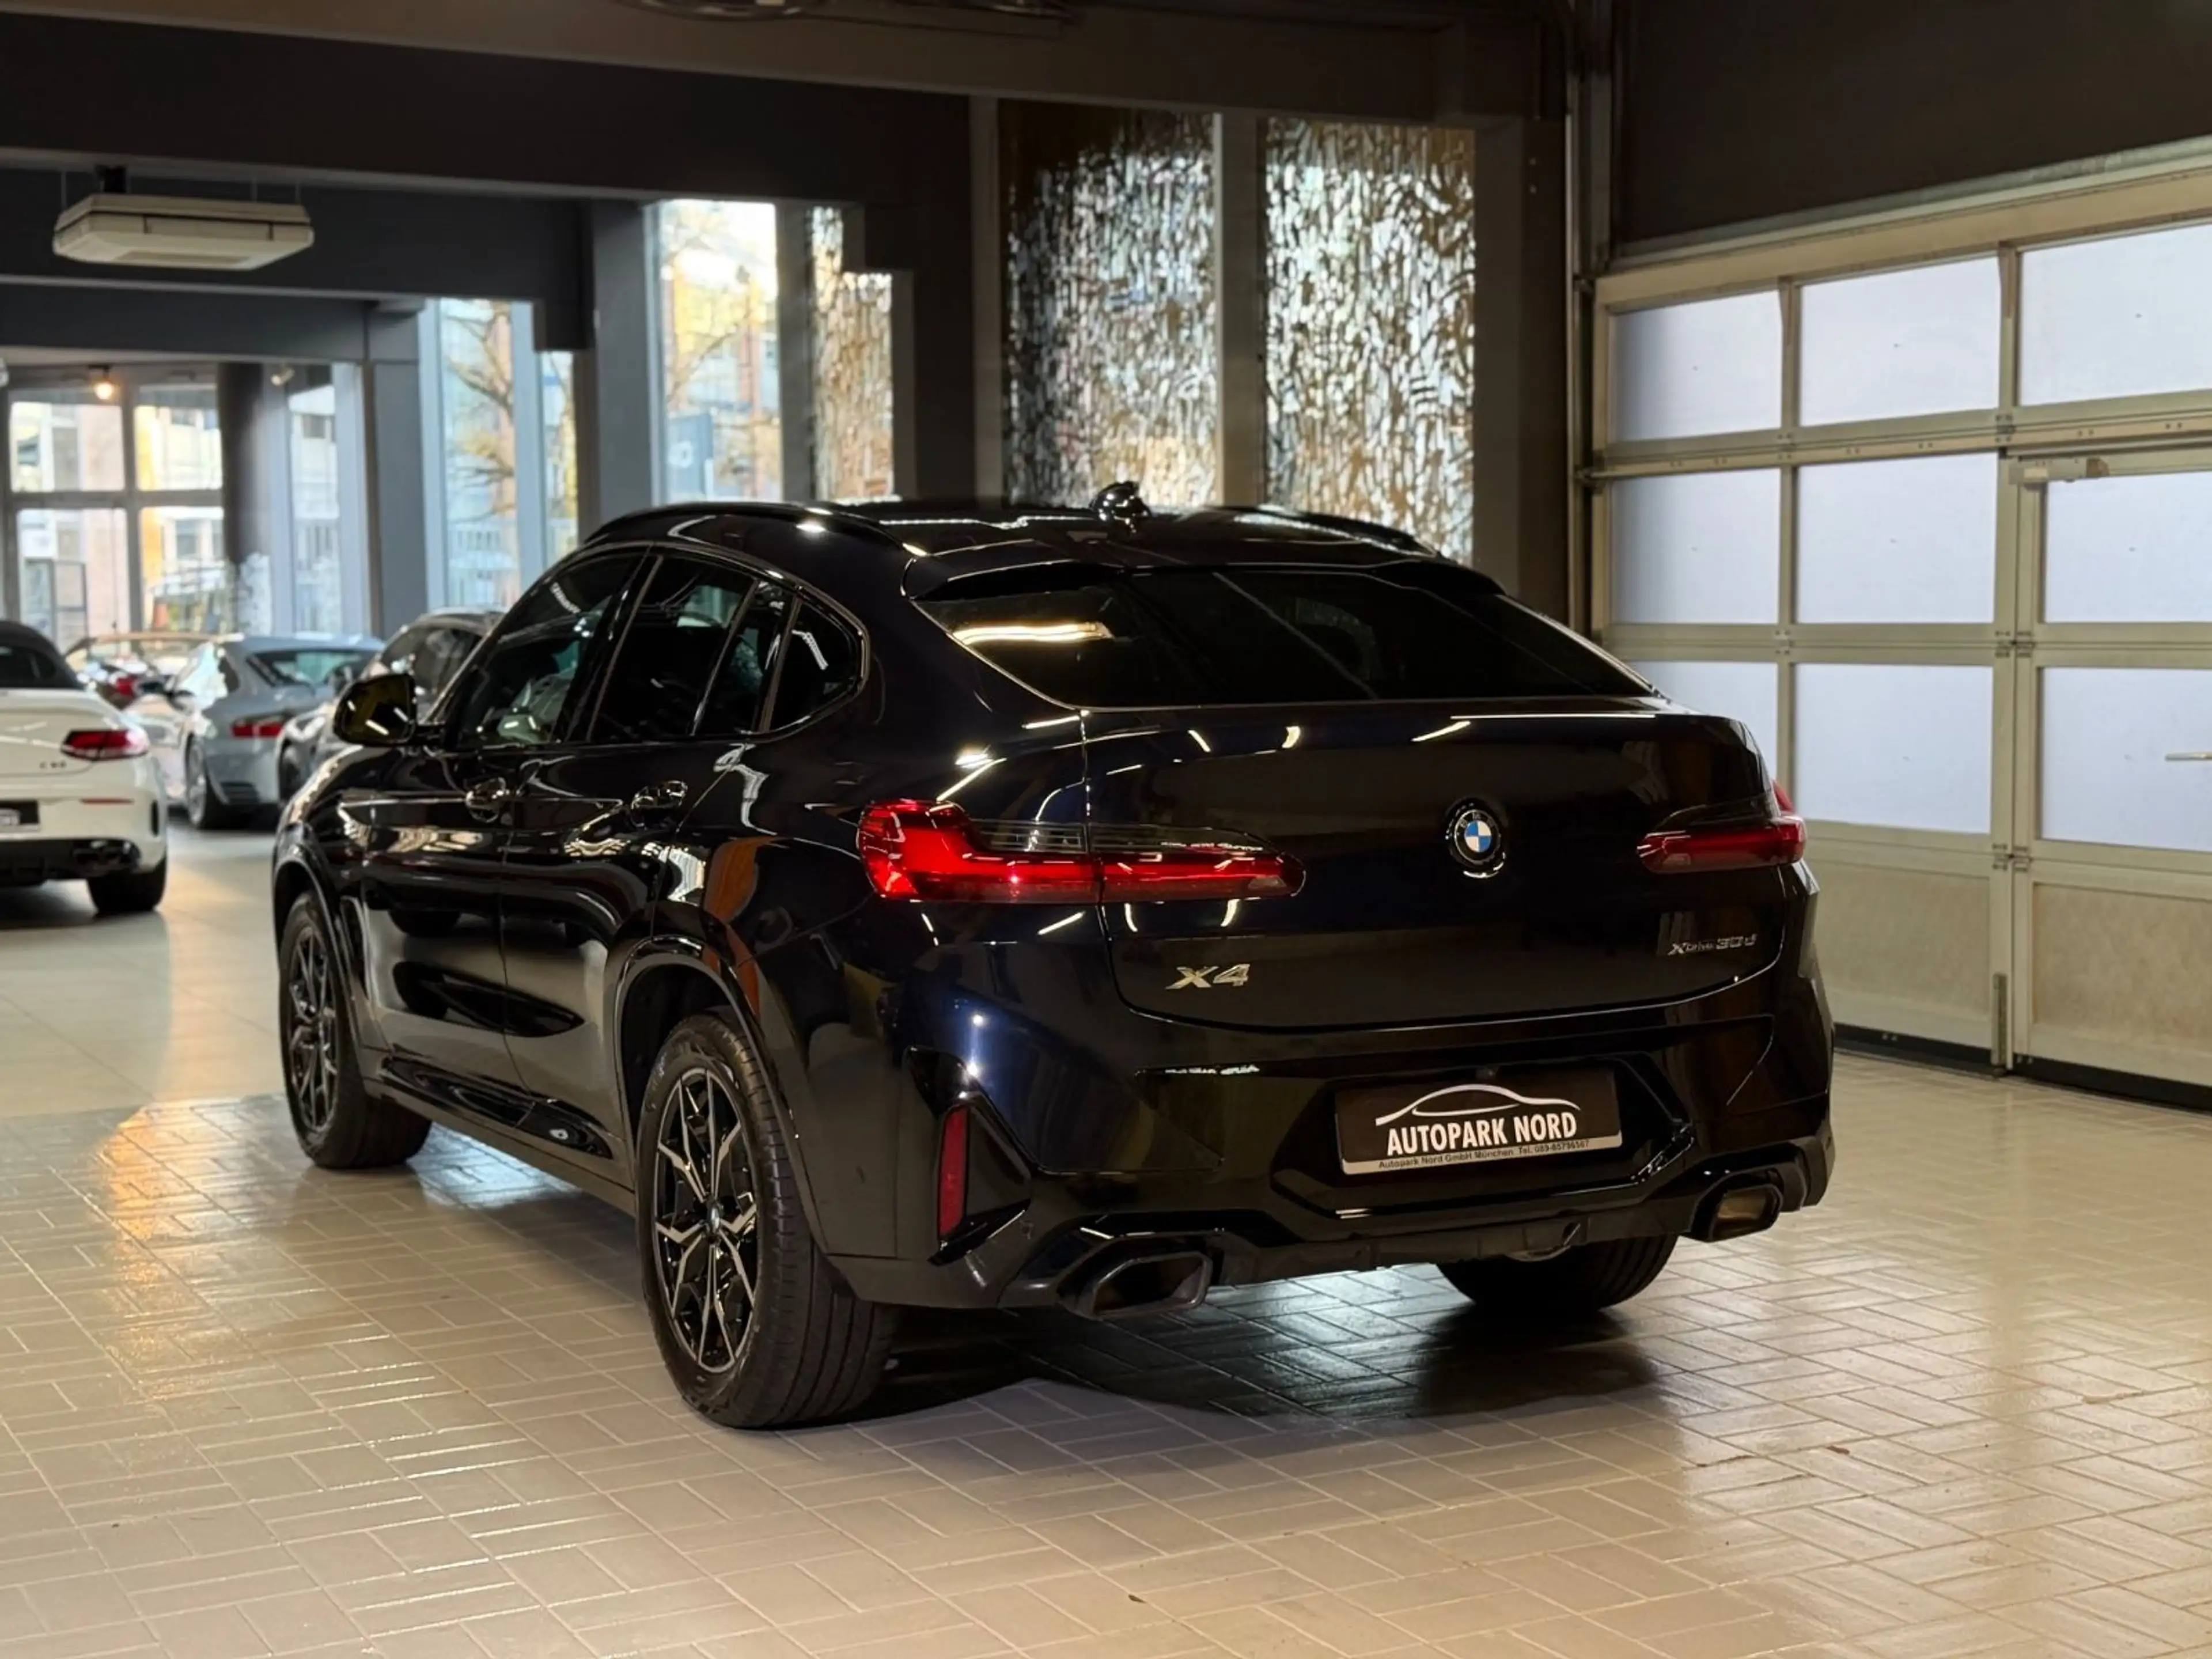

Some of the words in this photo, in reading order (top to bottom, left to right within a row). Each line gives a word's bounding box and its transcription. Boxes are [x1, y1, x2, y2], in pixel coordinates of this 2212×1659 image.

[1165, 964, 1251, 989] X4
[1387, 1118, 1508, 1156] AUTOPARK
[1514, 1112, 1577, 1142] NORD
[1378, 1159, 1418, 1169] Autopark
[1422, 1156, 1442, 1164] Nord
[1445, 1153, 1472, 1162] GmbH
[1475, 1149, 1513, 1159] München
